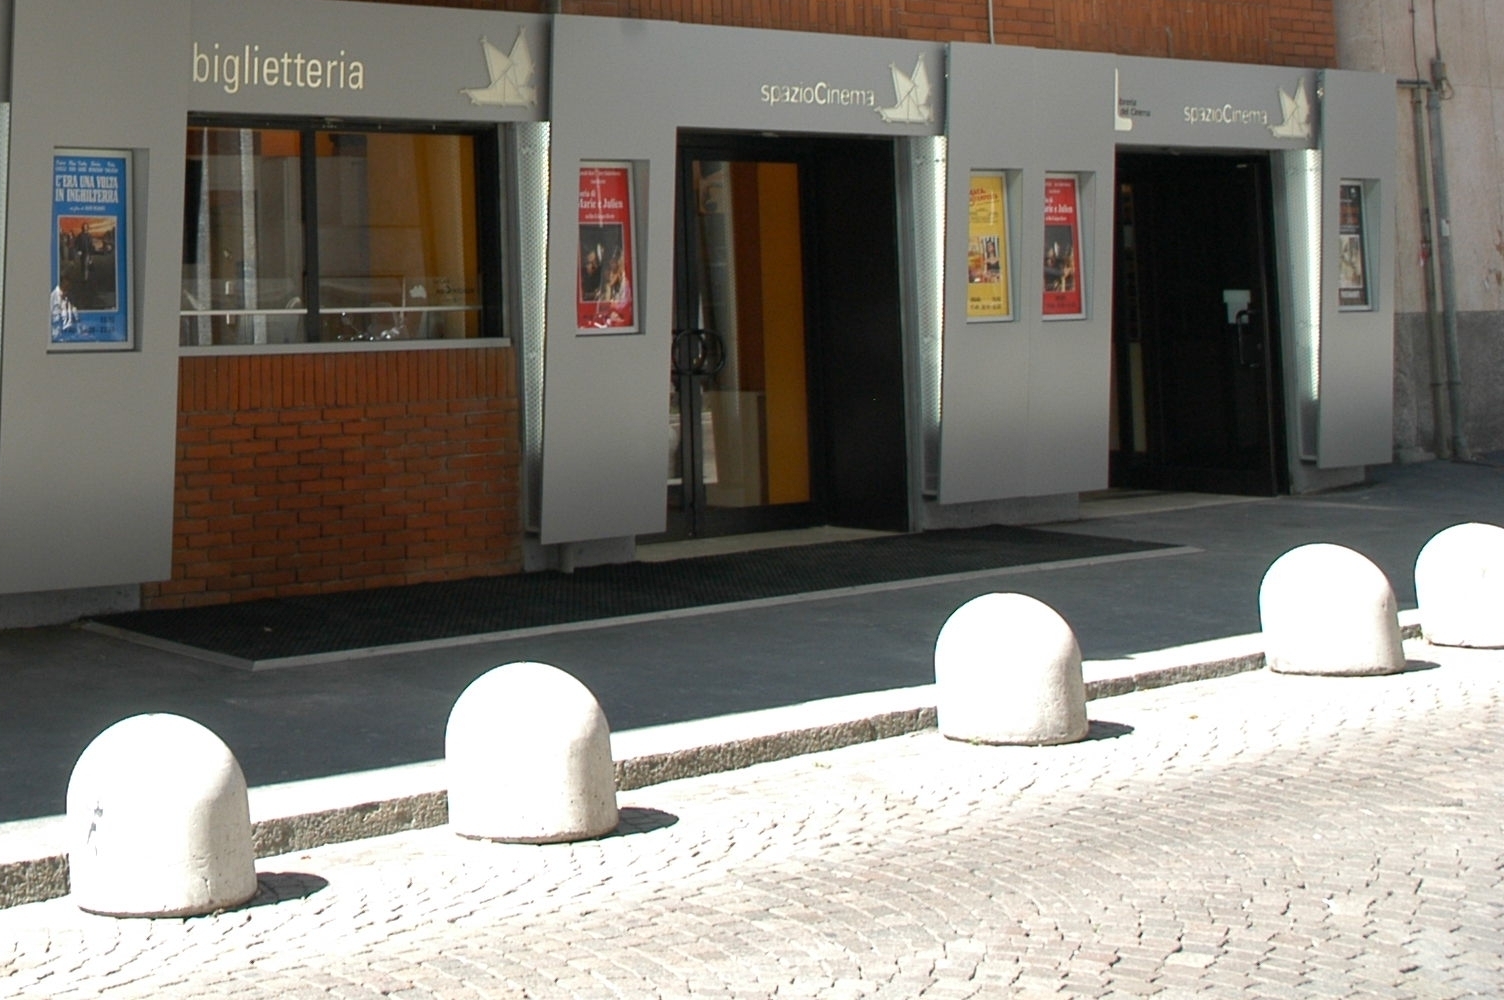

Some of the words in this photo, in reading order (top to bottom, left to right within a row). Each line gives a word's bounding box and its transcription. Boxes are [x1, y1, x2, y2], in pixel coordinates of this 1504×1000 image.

[192, 42, 365, 94] biglietteria
[760, 81, 875, 107] spazioCinema
[1183, 104, 1268, 125] spazioCinema
[79, 175, 95, 188] UNA
[96, 175, 118, 189] VOLTA
